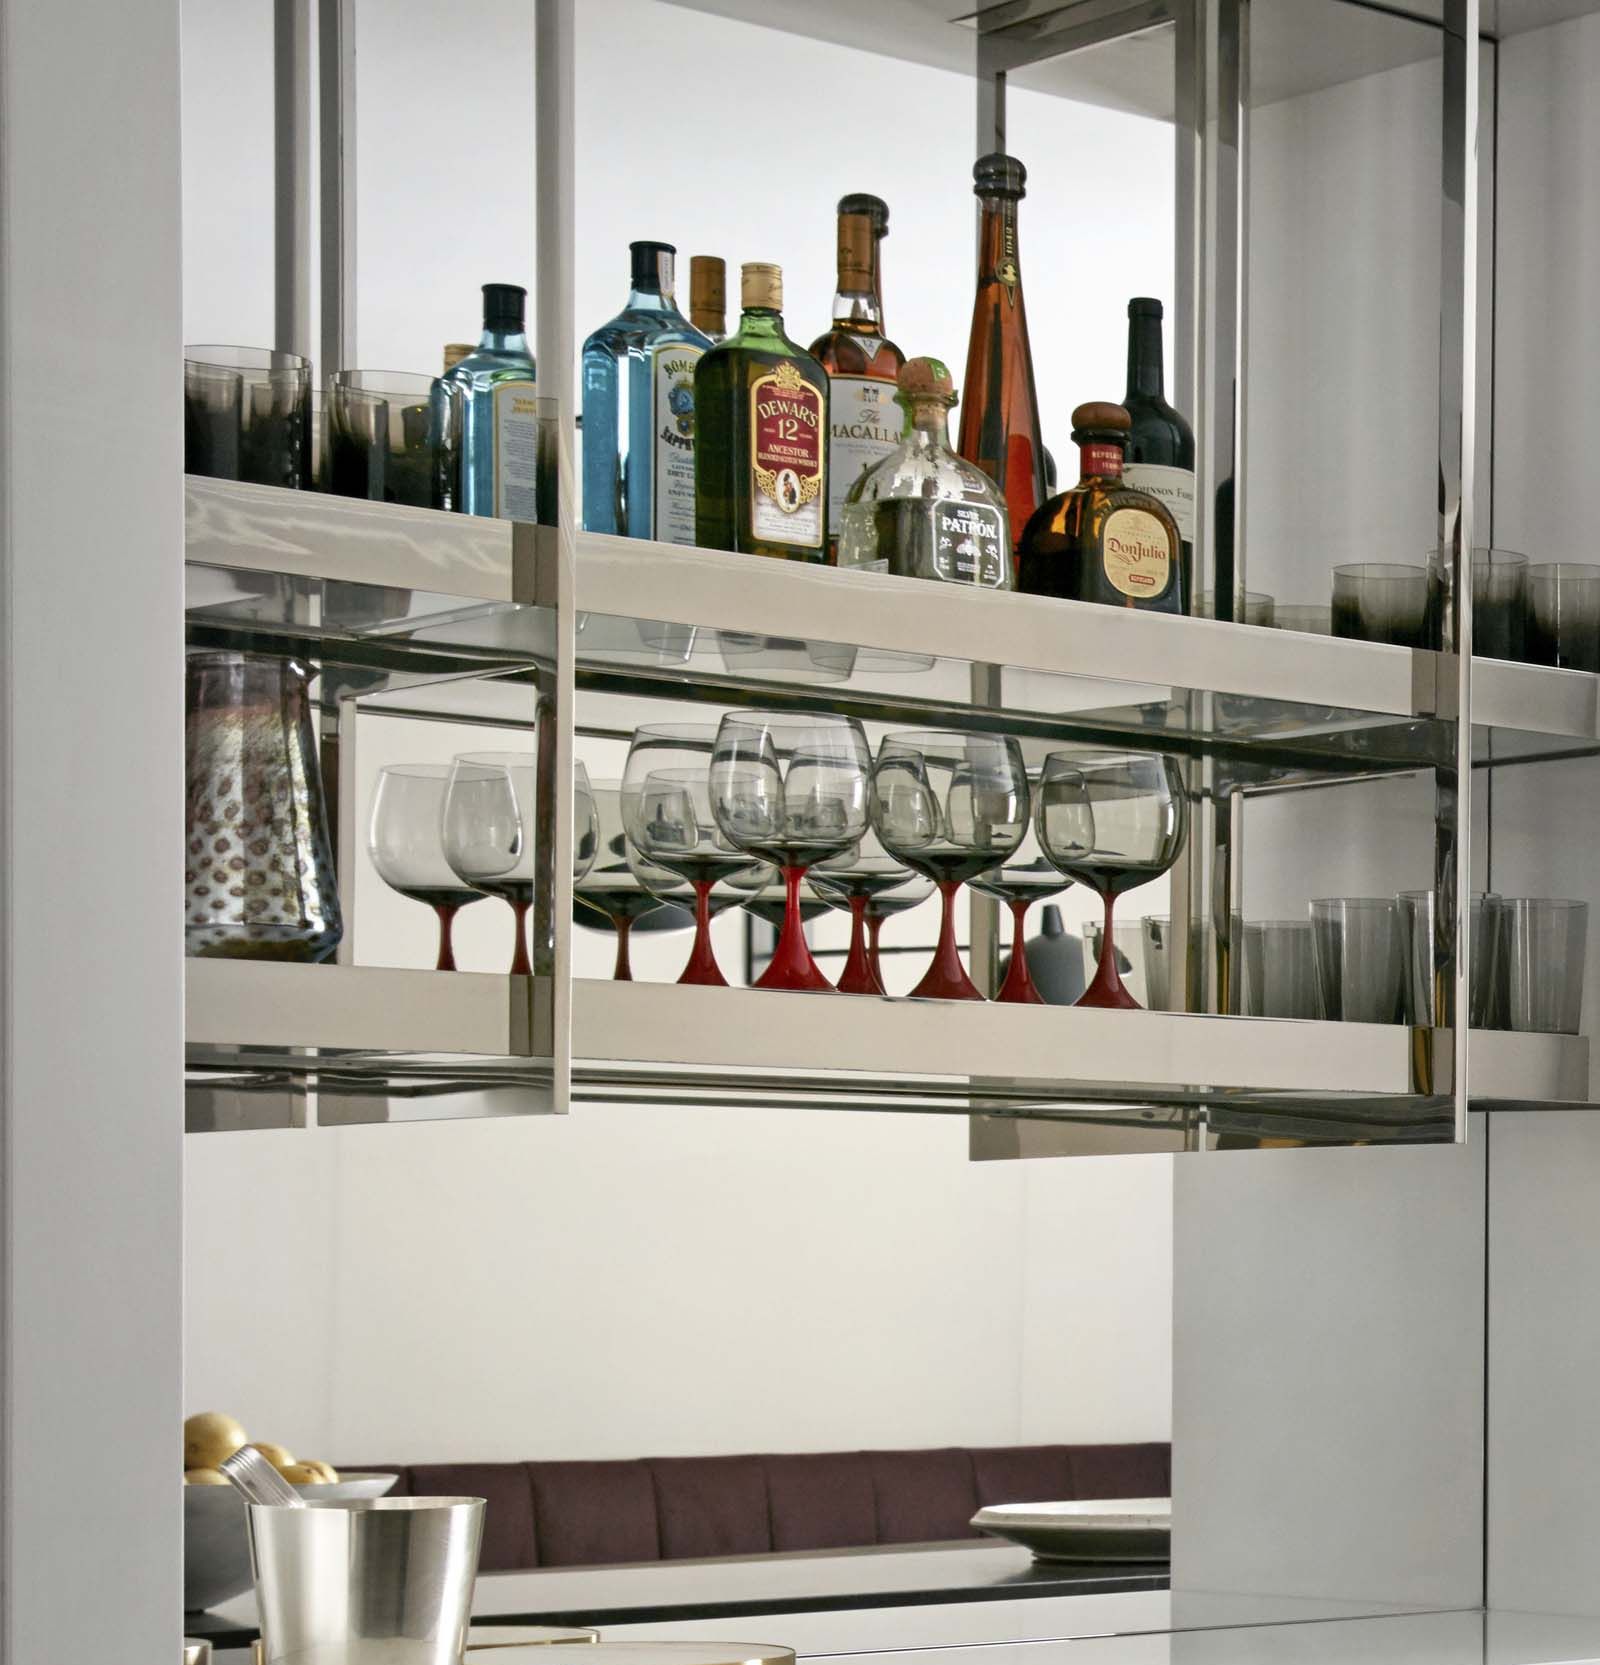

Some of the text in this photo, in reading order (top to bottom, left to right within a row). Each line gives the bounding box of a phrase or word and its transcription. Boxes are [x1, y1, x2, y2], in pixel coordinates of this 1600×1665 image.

[663, 359, 695, 378] BOMB
[757, 400, 818, 428] DEWAR'S
[778, 418, 798, 441] 12
[768, 444, 809, 458] ANCESTOR
